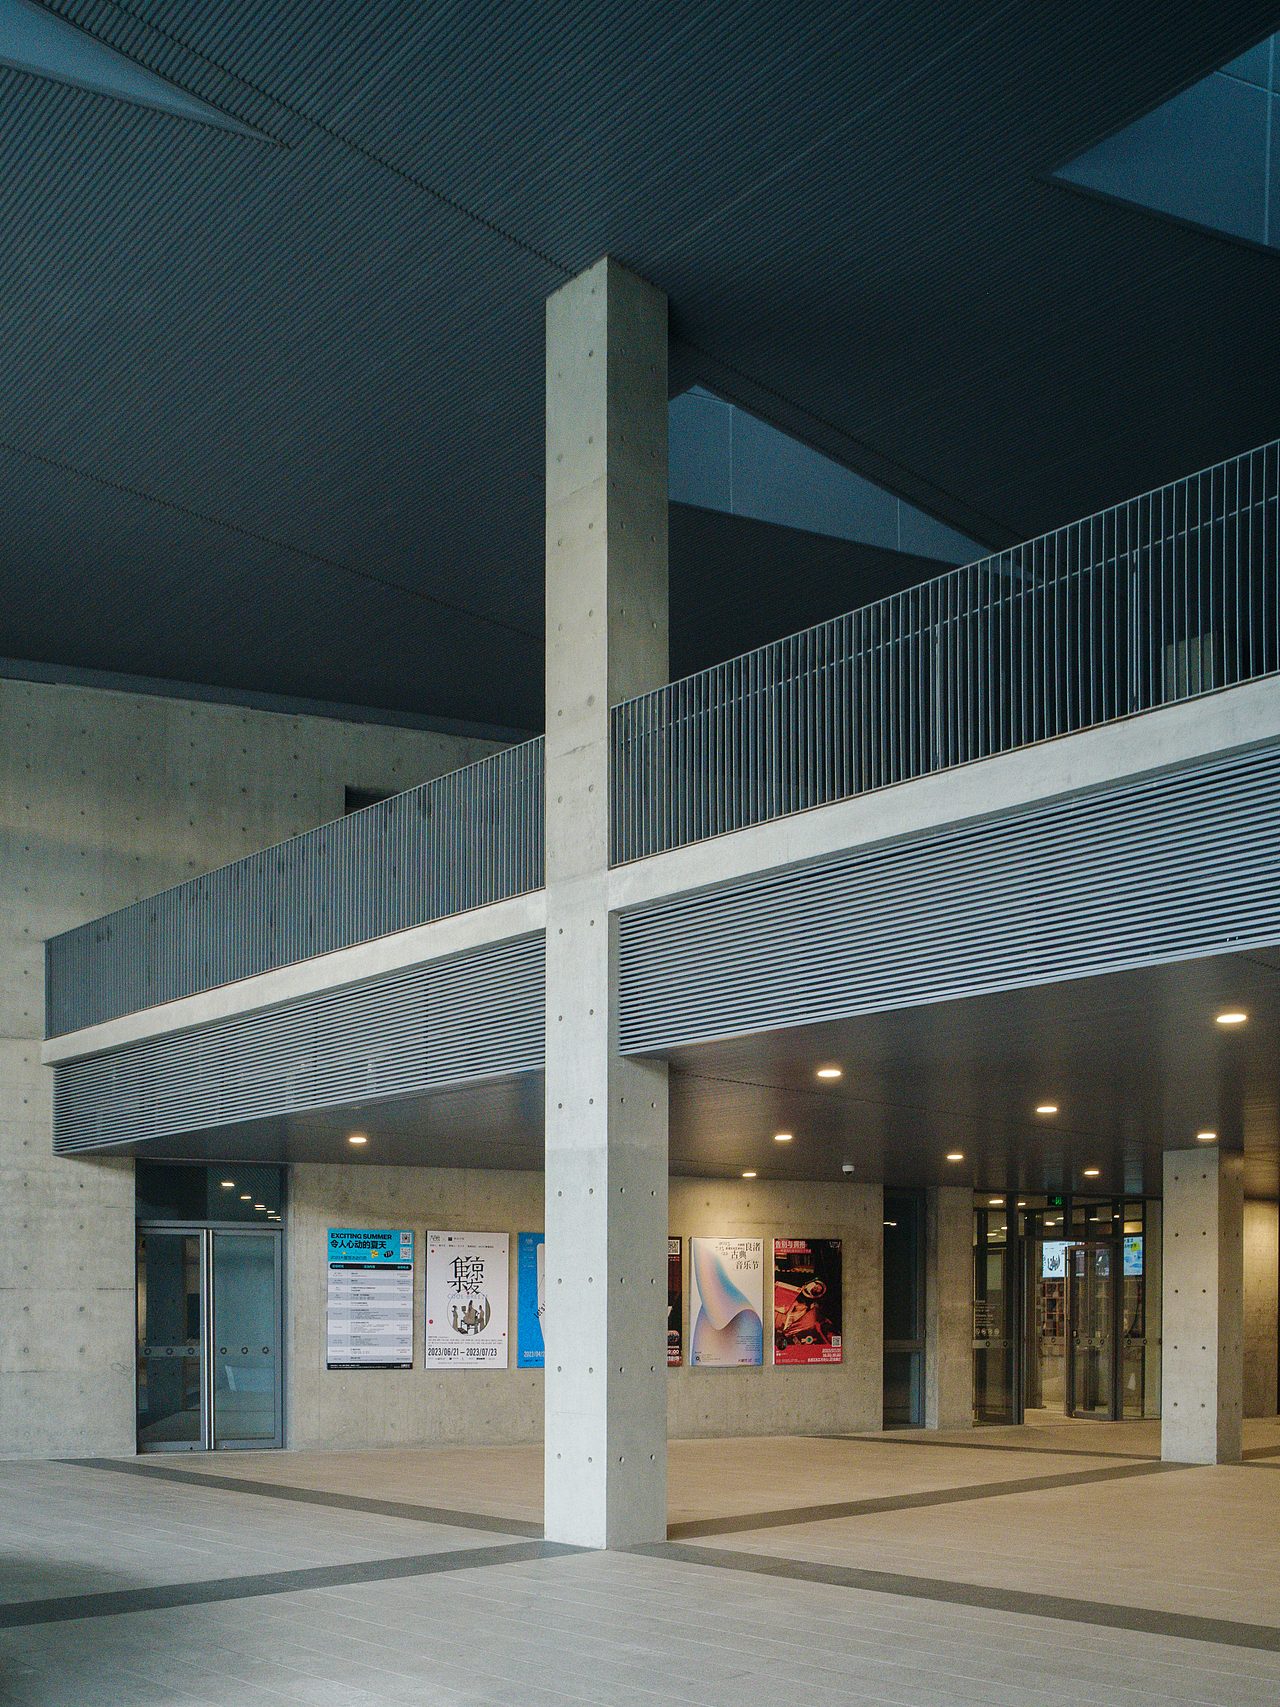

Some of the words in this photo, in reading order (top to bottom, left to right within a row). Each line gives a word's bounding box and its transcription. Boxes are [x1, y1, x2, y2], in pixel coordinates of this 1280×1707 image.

[330, 1240, 386, 1249] 令人心动的夏天
[736, 1260, 760, 1270] 音乐节
[428, 1348, 459, 1356] 2023/06/21
[466, 1348, 498, 1356] 2023/07/23
